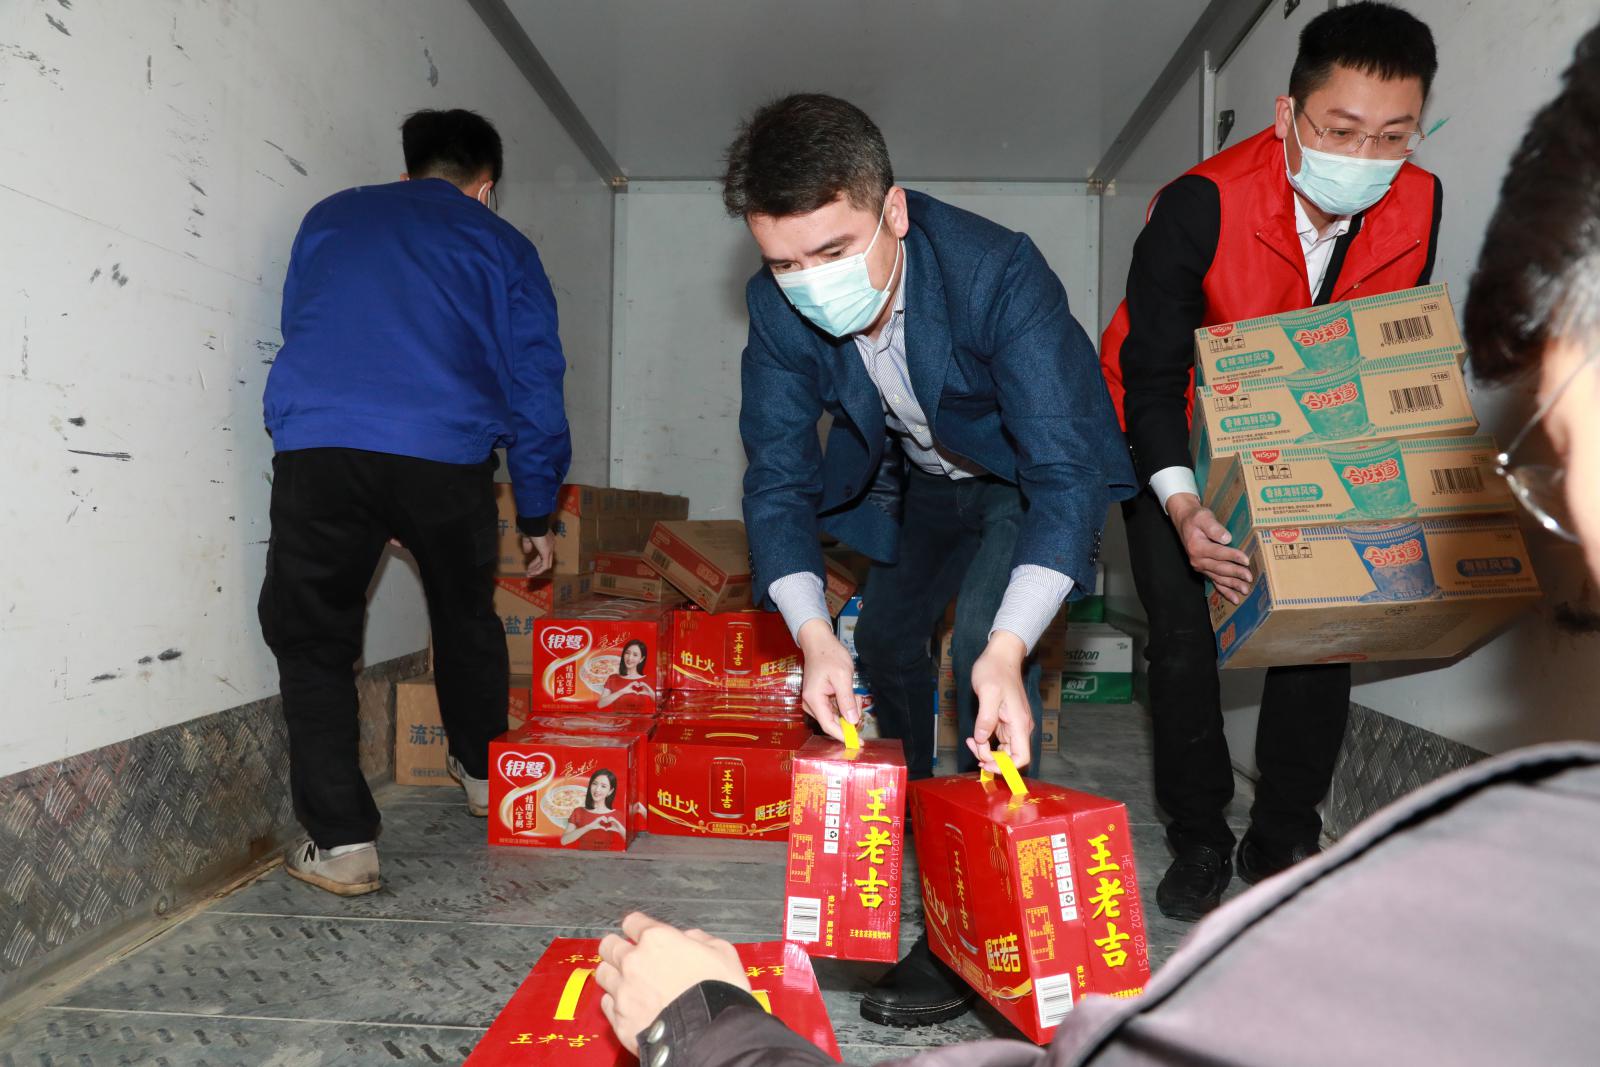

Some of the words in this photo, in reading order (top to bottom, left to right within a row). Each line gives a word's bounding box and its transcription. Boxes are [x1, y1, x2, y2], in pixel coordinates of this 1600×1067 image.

[1211, 325, 1232, 334] NISSIN
[1293, 317, 1350, 347] 合味道
[1215, 383, 1237, 391] NISSIN
[1301, 382, 1358, 410] 合味道
[1255, 451, 1278, 459] NISSIN
[1342, 458, 1399, 484] 合味道
[1363, 539, 1423, 569] 合味道
[547, 634, 583, 650] 银鹭
[733, 632, 744, 666] 王老吉
[681, 650, 715, 674] 怕上火
[505, 760, 546, 778] 银鹭
[721, 769, 734, 809] 王老吉
[657, 788, 699, 817] 怕上火
[755, 799, 791, 821] 喝王老
[892, 815, 901, 828] HE
[854, 788, 893, 910] 王老吉
[889, 833, 900, 881] 20211202
[1121, 854, 1133, 870] HE
[888, 887, 898, 906] 029
[953, 850, 969, 930] 王老吉
[1087, 833, 1130, 968] 王老吉
[1124, 875, 1142, 929] 20211202
[1134, 934, 1146, 956] 025
[510, 1033, 591, 1048] 王老吉
